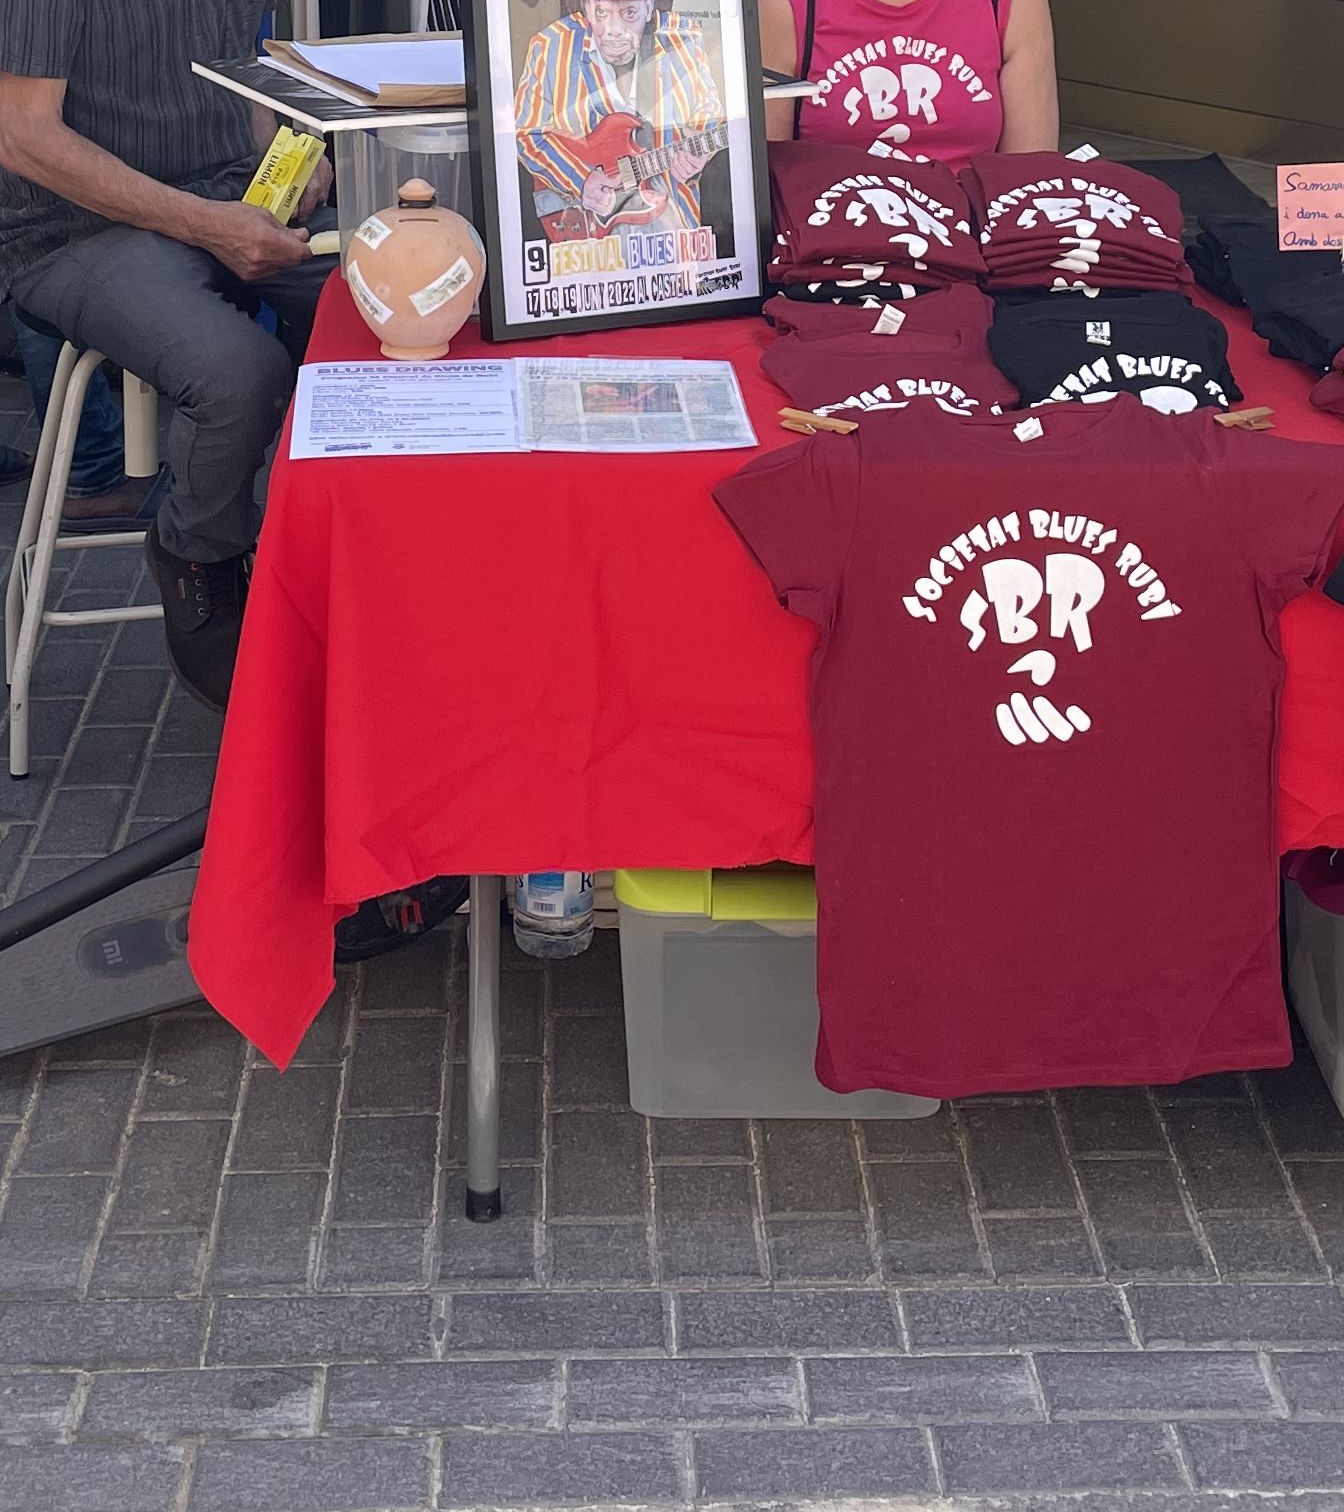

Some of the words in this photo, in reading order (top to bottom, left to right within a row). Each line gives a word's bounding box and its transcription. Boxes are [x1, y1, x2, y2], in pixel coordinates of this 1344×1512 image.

[842, 63, 943, 126] SBR
[526, 246, 548, 272] 9
[550, 235, 626, 277] FESTIVAL
[628, 232, 675, 270] BLUES
[608, 279, 636, 308] 2022
[317, 366, 390, 375] BLUES
[395, 364, 504, 374] DRAWING
[1115, 353, 1202, 383] BLUES
[1028, 508, 1118, 555] BLUES
[959, 552, 1106, 653] SBR
